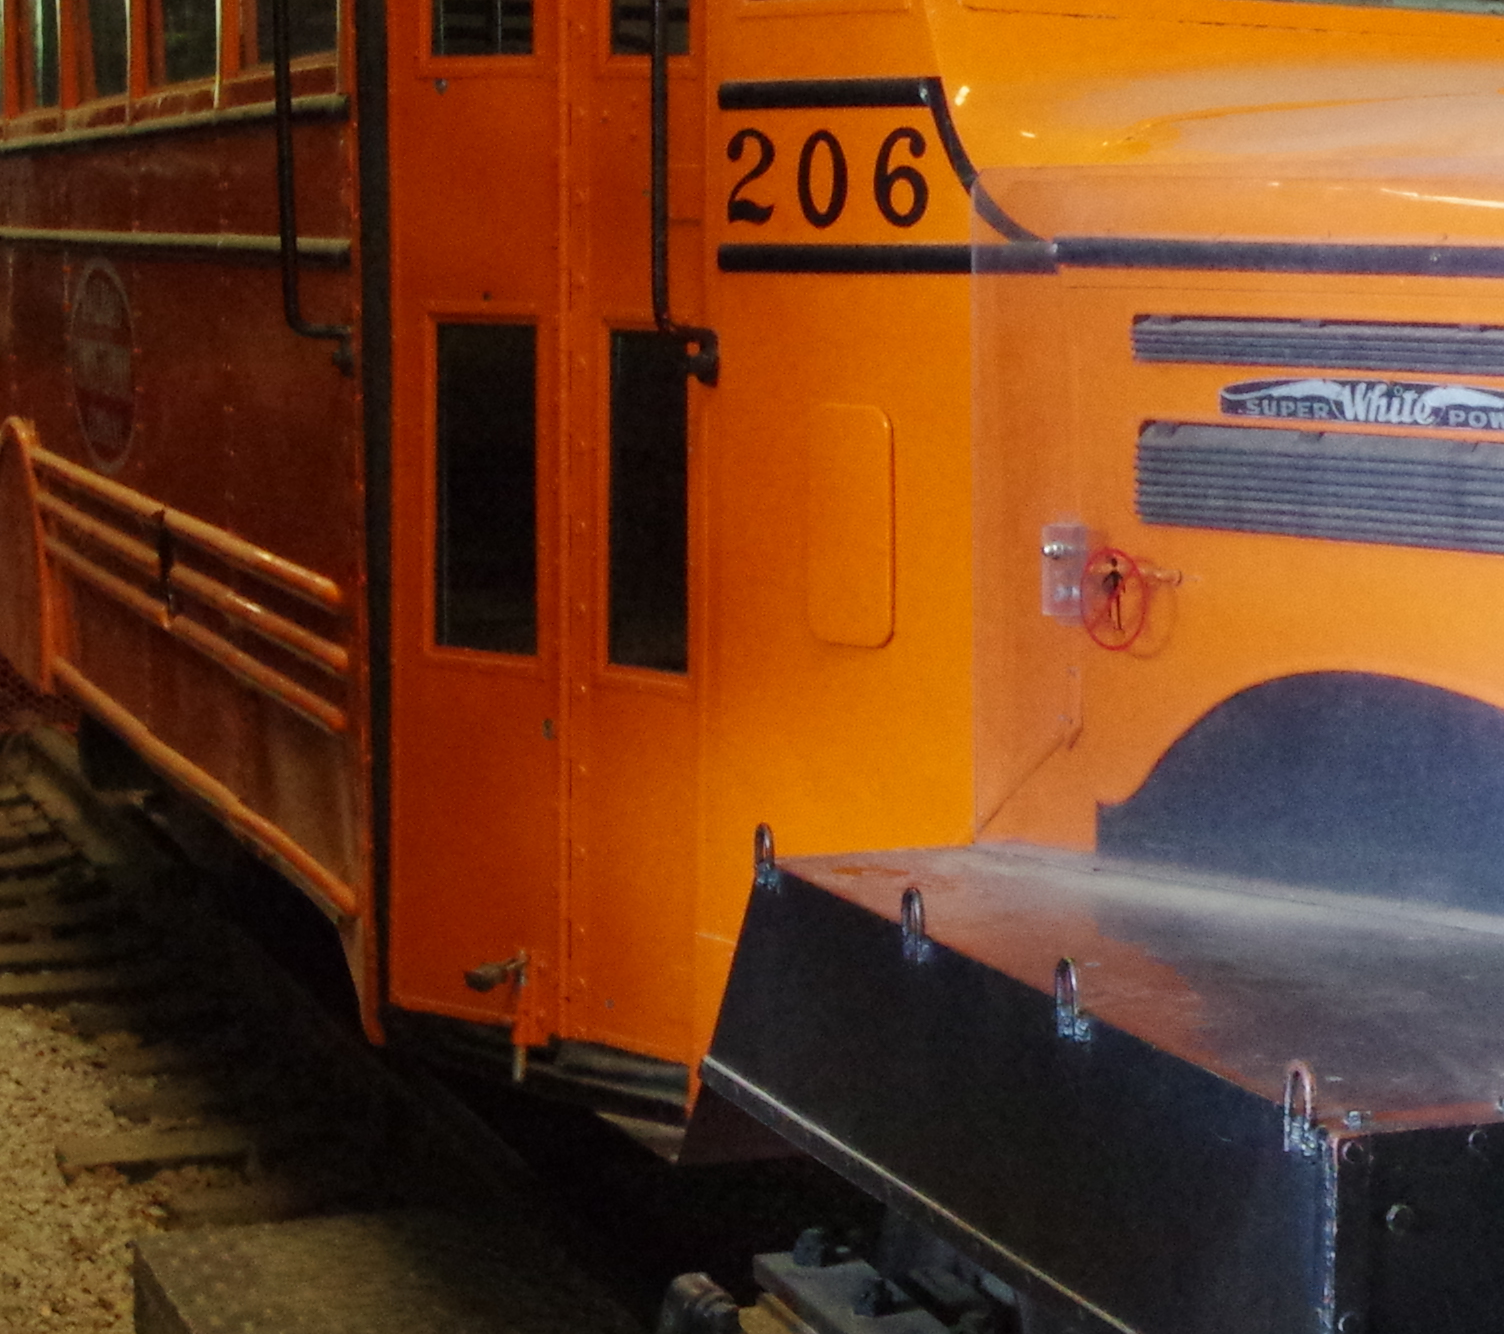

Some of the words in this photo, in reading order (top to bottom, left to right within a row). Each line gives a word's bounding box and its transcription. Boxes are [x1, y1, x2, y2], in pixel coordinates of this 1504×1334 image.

[726, 127, 929, 229] 206
[1246, 399, 1330, 419] SUPER
[1341, 383, 1438, 426] White
